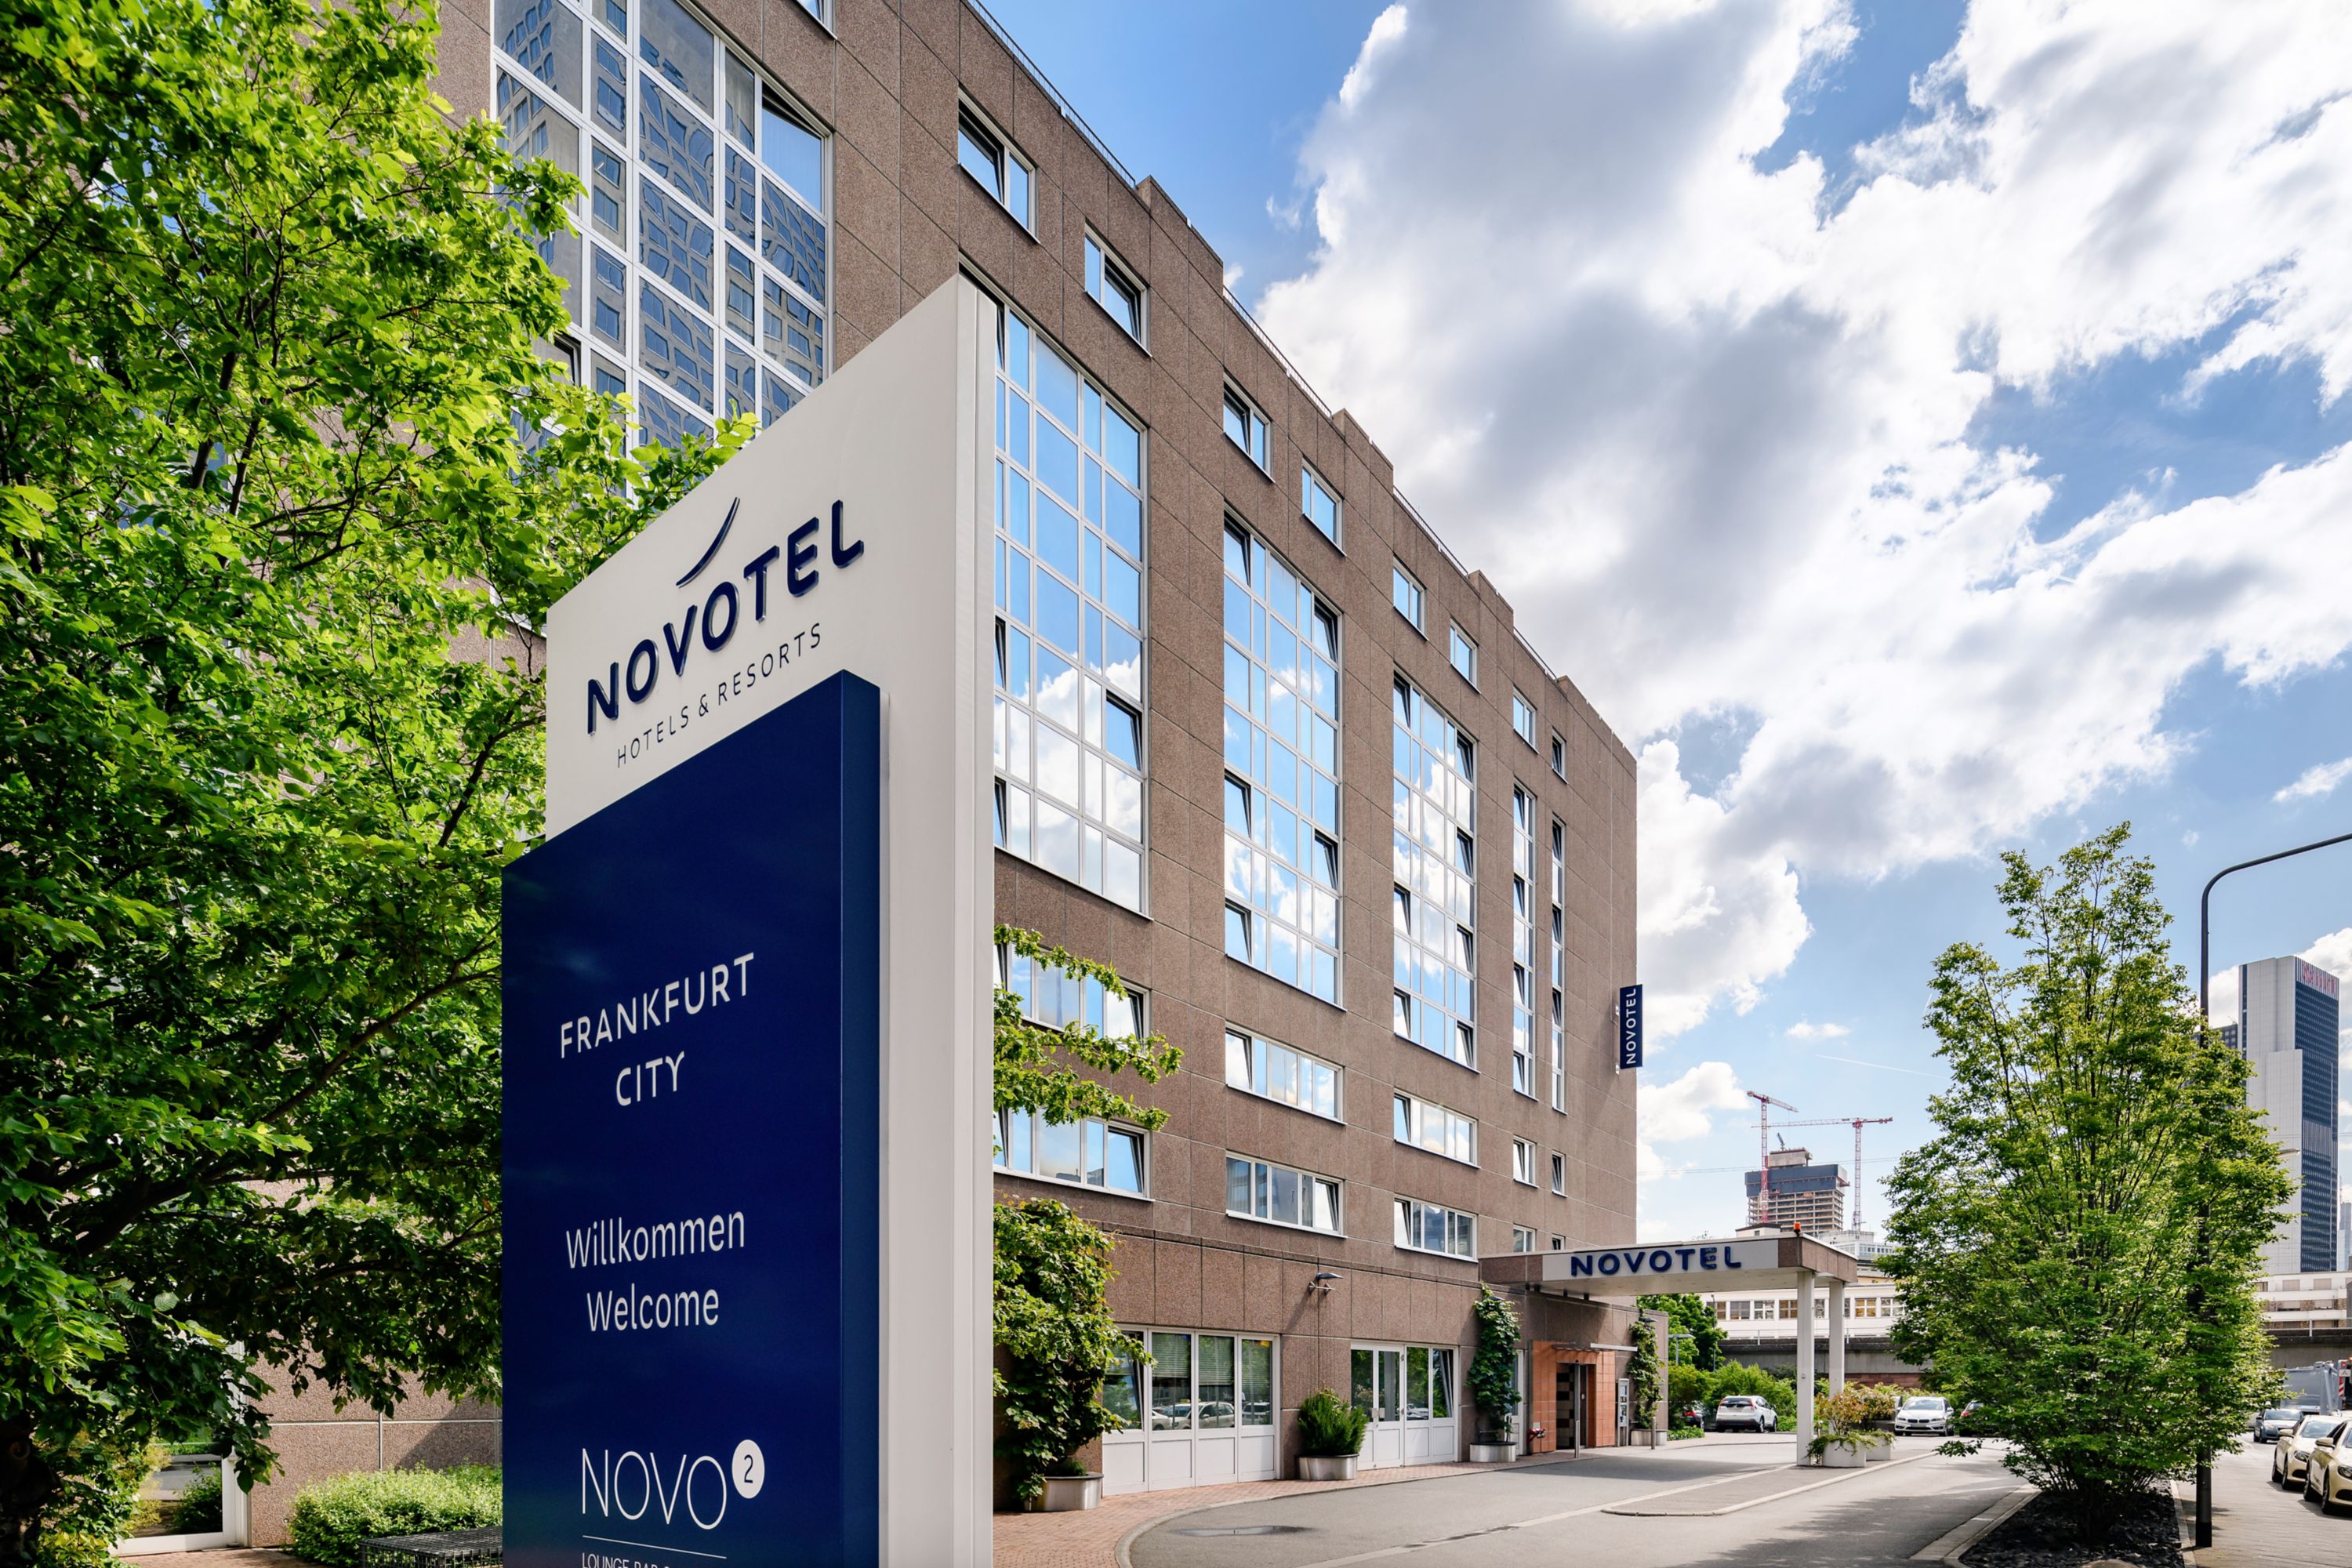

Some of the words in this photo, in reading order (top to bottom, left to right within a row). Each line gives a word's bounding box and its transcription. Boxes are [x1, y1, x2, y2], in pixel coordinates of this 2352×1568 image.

[587, 499, 864, 735] NOVOTEL
[617, 706, 690, 768] HOTELS
[699, 695, 710, 717] &
[717, 622, 822, 706] RESORTS
[561, 952, 754, 1058] FRANKFURT
[1626, 989, 1636, 1064] NOVOTEL
[616, 1051, 684, 1106] CITY
[566, 1211, 744, 1269] Willkommen
[1570, 1247, 1742, 1277] NOVOTEL
[586, 1283, 719, 1331] Welcome
